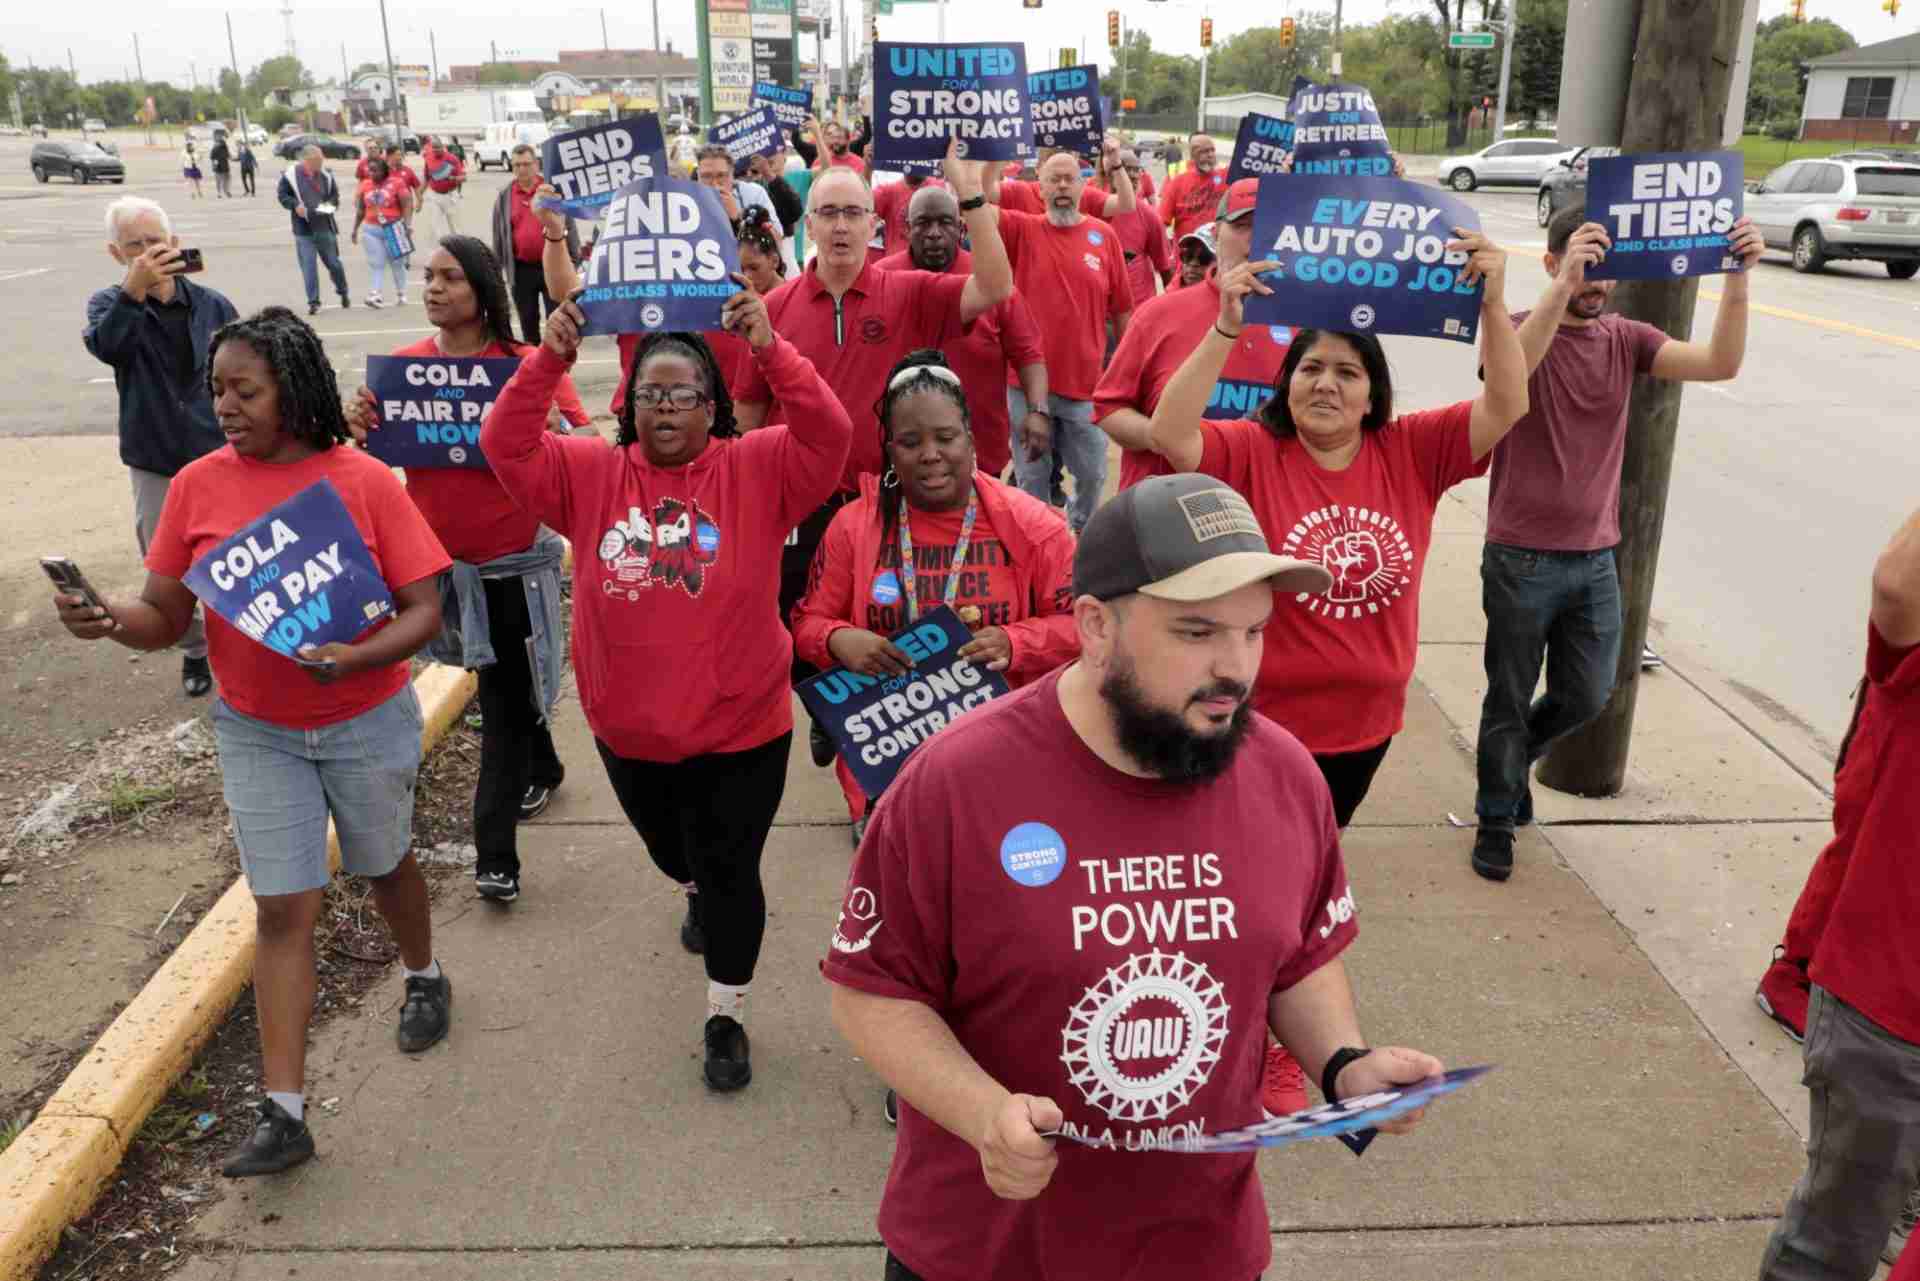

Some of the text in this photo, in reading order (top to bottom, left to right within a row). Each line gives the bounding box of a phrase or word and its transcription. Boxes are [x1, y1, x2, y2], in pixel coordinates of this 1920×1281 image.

[889, 48, 1016, 77] UNITED
[756, 83, 807, 103] UNITED
[889, 88, 1021, 115] STRONG
[942, 80, 980, 90] FOR A
[1031, 97, 1090, 118] RONG
[1297, 92, 1378, 114] JUSTIC
[1328, 112, 1360, 124] FOR
[718, 112, 766, 140] SAVING
[888, 117, 1024, 138] CONTRACT
[557, 128, 633, 170] END
[551, 155, 653, 199] TIERS
[1632, 160, 1722, 200] END
[602, 192, 701, 240] END
[1312, 198, 1441, 232] EVERY
[1609, 198, 1734, 239] TIERS
[1273, 225, 1383, 258] AUTO
[1614, 240, 1645, 253] 2ND
[1295, 255, 1399, 288] GOOD
[615, 283, 667, 299] CLASS
[405, 363, 492, 387] COLA
[434, 388, 465, 399] AND
[383, 400, 454, 421] FAIR
[210, 518, 300, 591] COLA
[249, 562, 281, 595] AND
[281, 541, 344, 605] PAY
[814, 623, 949, 704] UNED
[844, 659, 982, 743] STRONG
[881, 678, 908, 694] FOR
[860, 684, 995, 766] CONTRACT
[1010, 847, 1058, 863] STRONG
[1011, 856, 1058, 871] CONTRACT
[1079, 852, 1223, 894] THERE IS
[1071, 896, 1239, 950] POWER
[1113, 1017, 1183, 1061] UAW
[1126, 1117, 1206, 1151] UNION
